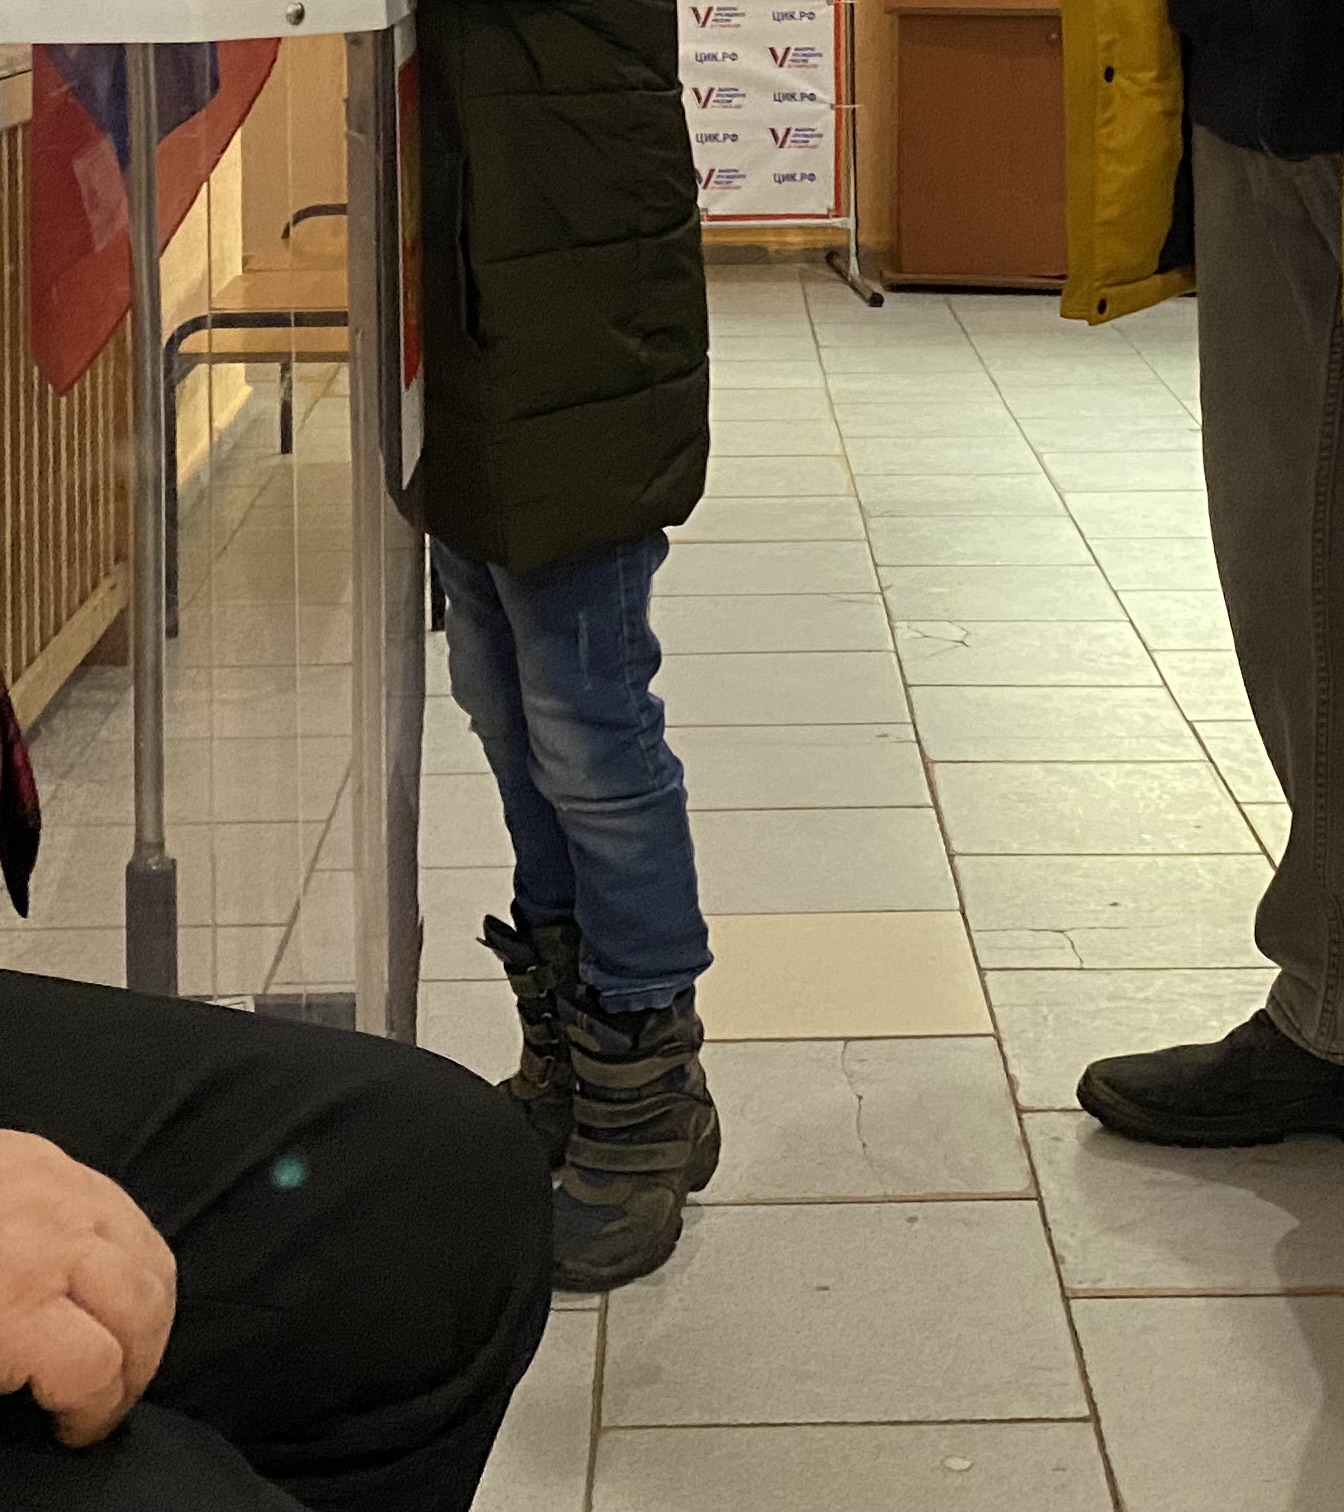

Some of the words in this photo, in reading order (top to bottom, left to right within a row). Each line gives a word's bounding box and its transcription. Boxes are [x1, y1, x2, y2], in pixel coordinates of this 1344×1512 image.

[772, 11, 816, 22] ЦИК.РФ
[695, 52, 738, 64] ЦИК.РФ
[773, 92, 817, 103] ЦИК.РФ
[696, 133, 738, 145] ЦИК.РФ
[773, 173, 816, 184] ЦИК.РФ
